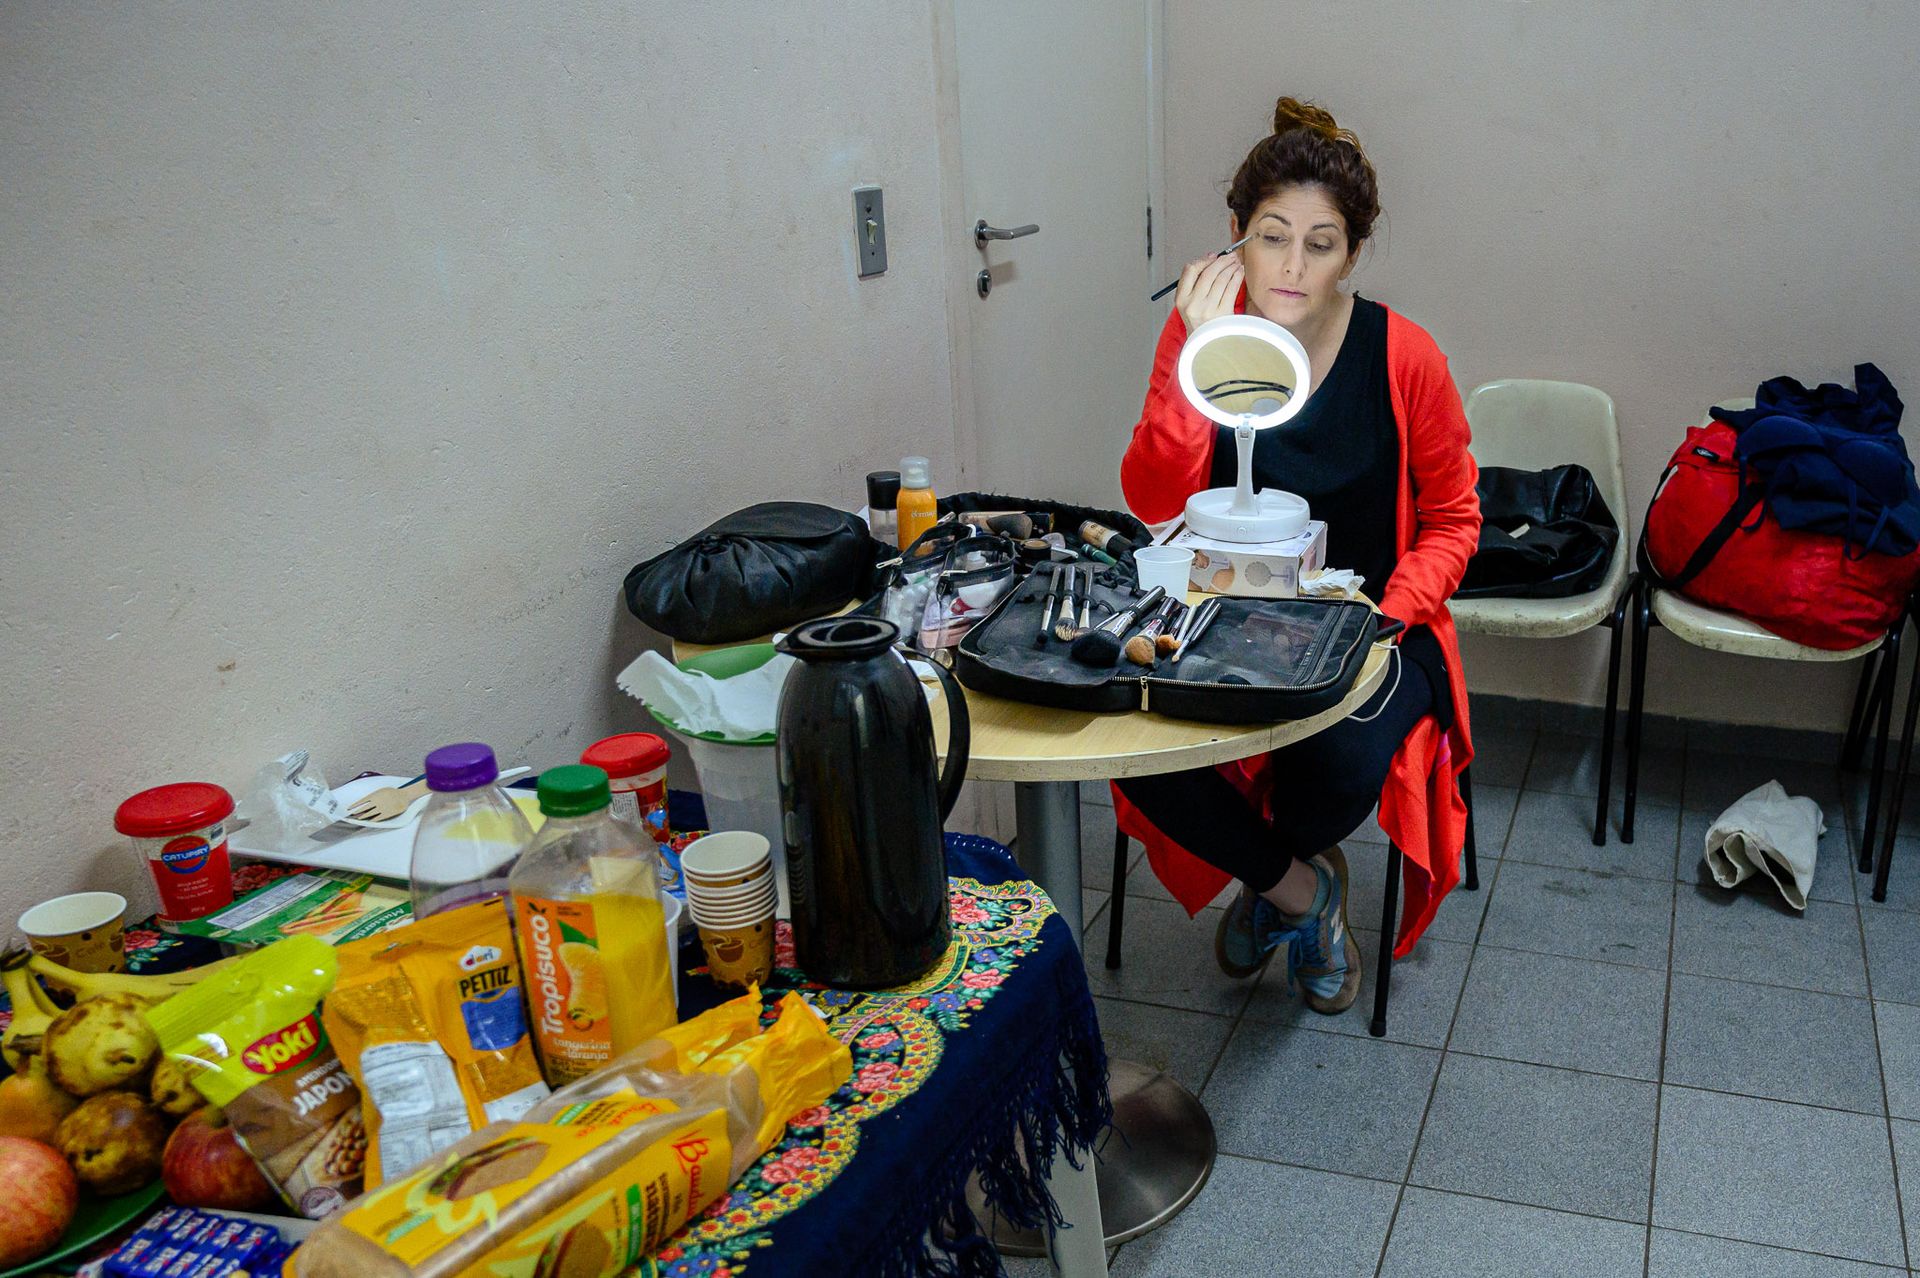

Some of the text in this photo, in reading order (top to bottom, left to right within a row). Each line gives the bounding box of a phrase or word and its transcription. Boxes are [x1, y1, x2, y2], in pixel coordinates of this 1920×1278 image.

[459, 965, 513, 998] PETTIZ
[530, 914, 565, 1035] Tropisuco
[246, 1020, 317, 1073] Yoki
